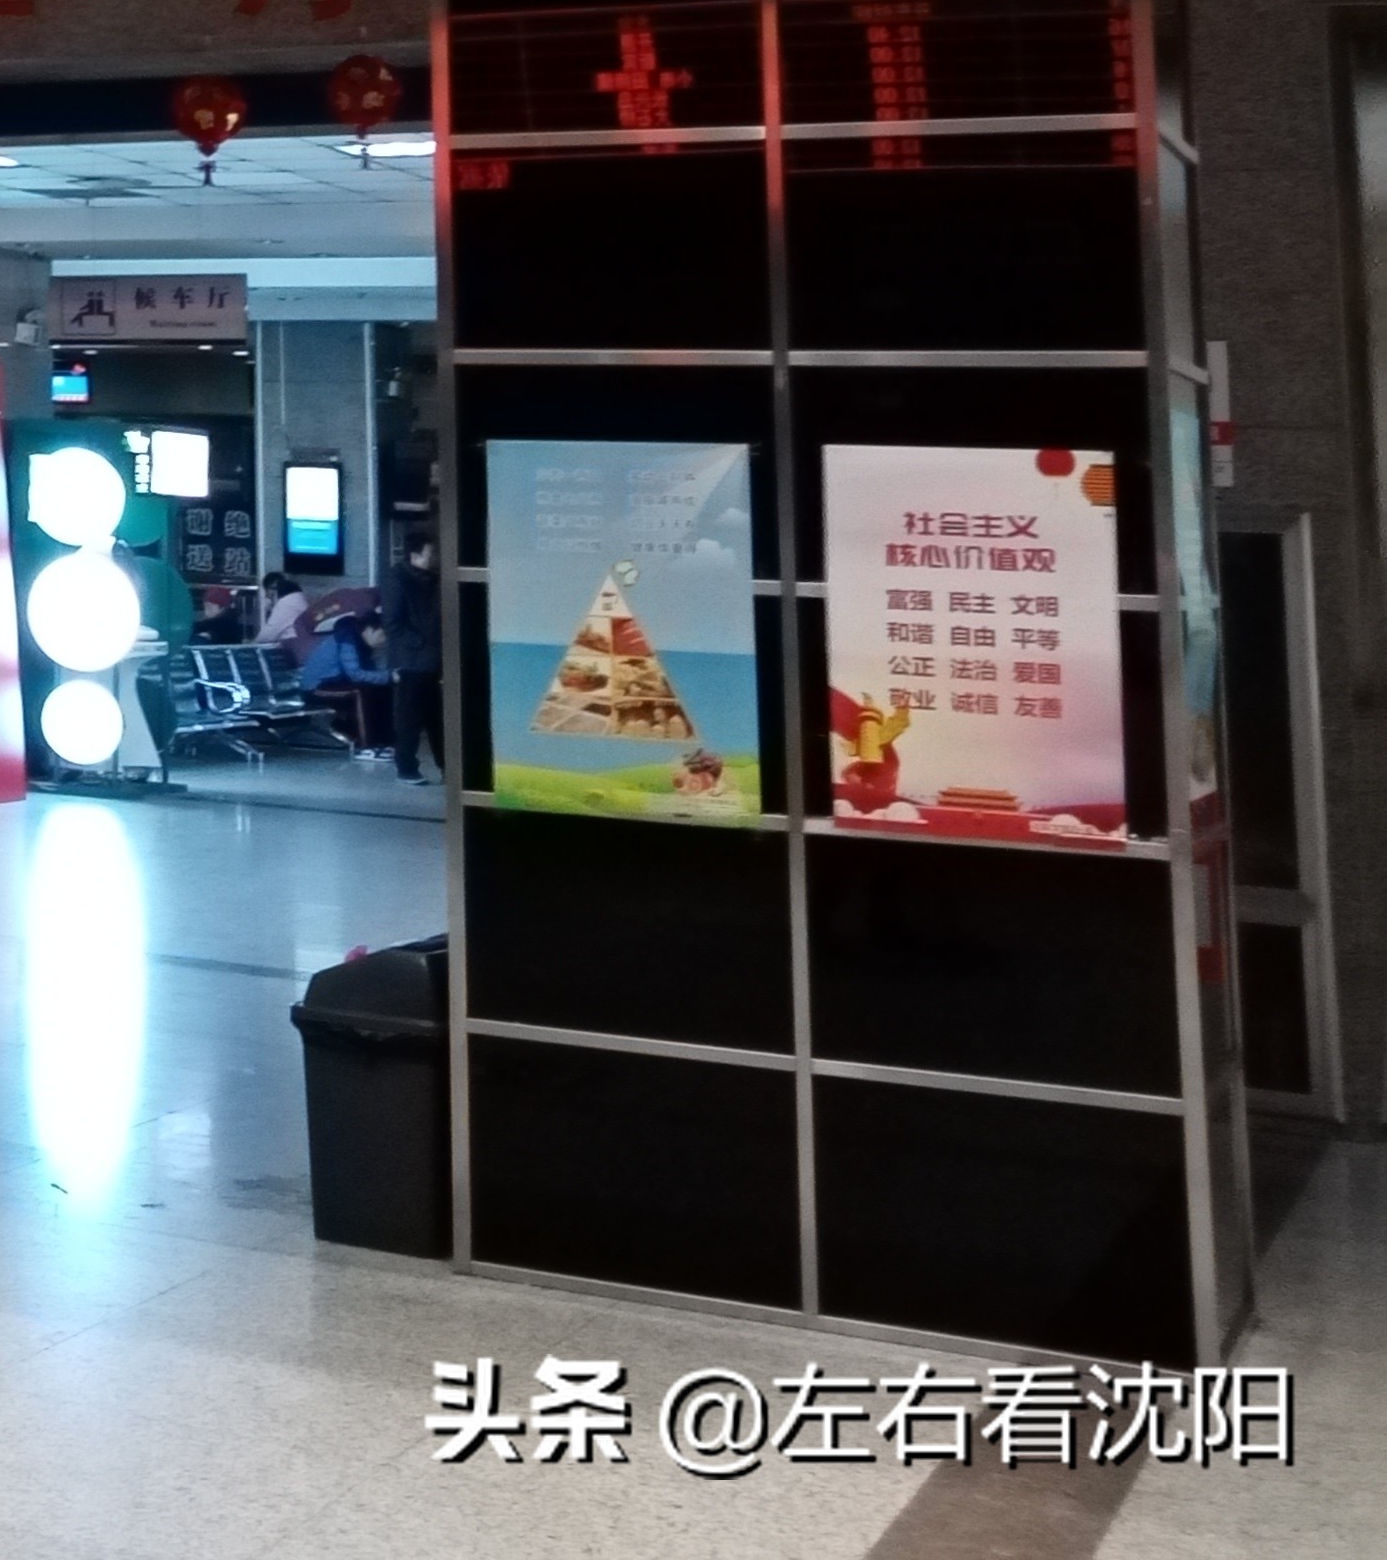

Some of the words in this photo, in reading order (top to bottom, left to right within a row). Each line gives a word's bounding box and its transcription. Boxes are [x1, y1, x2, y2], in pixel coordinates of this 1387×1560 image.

[134, 287, 229, 310] 候车厅
[903, 511, 1040, 539] 社会主义
[885, 543, 1057, 574] 核心价值观
[886, 589, 933, 611] 富强
[948, 591, 996, 614] 民主
[1010, 594, 1060, 618] 文明
[887, 621, 934, 644] 和谐
[950, 625, 996, 648] 自由
[1011, 627, 1061, 652] 平等
[888, 655, 936, 678] 公正
[950, 657, 998, 681] 法治
[1012, 661, 1062, 686] 爱国
[888, 688, 937, 711] 敬业
[950, 692, 999, 715] 诚信
[1014, 695, 1063, 720] 友善
